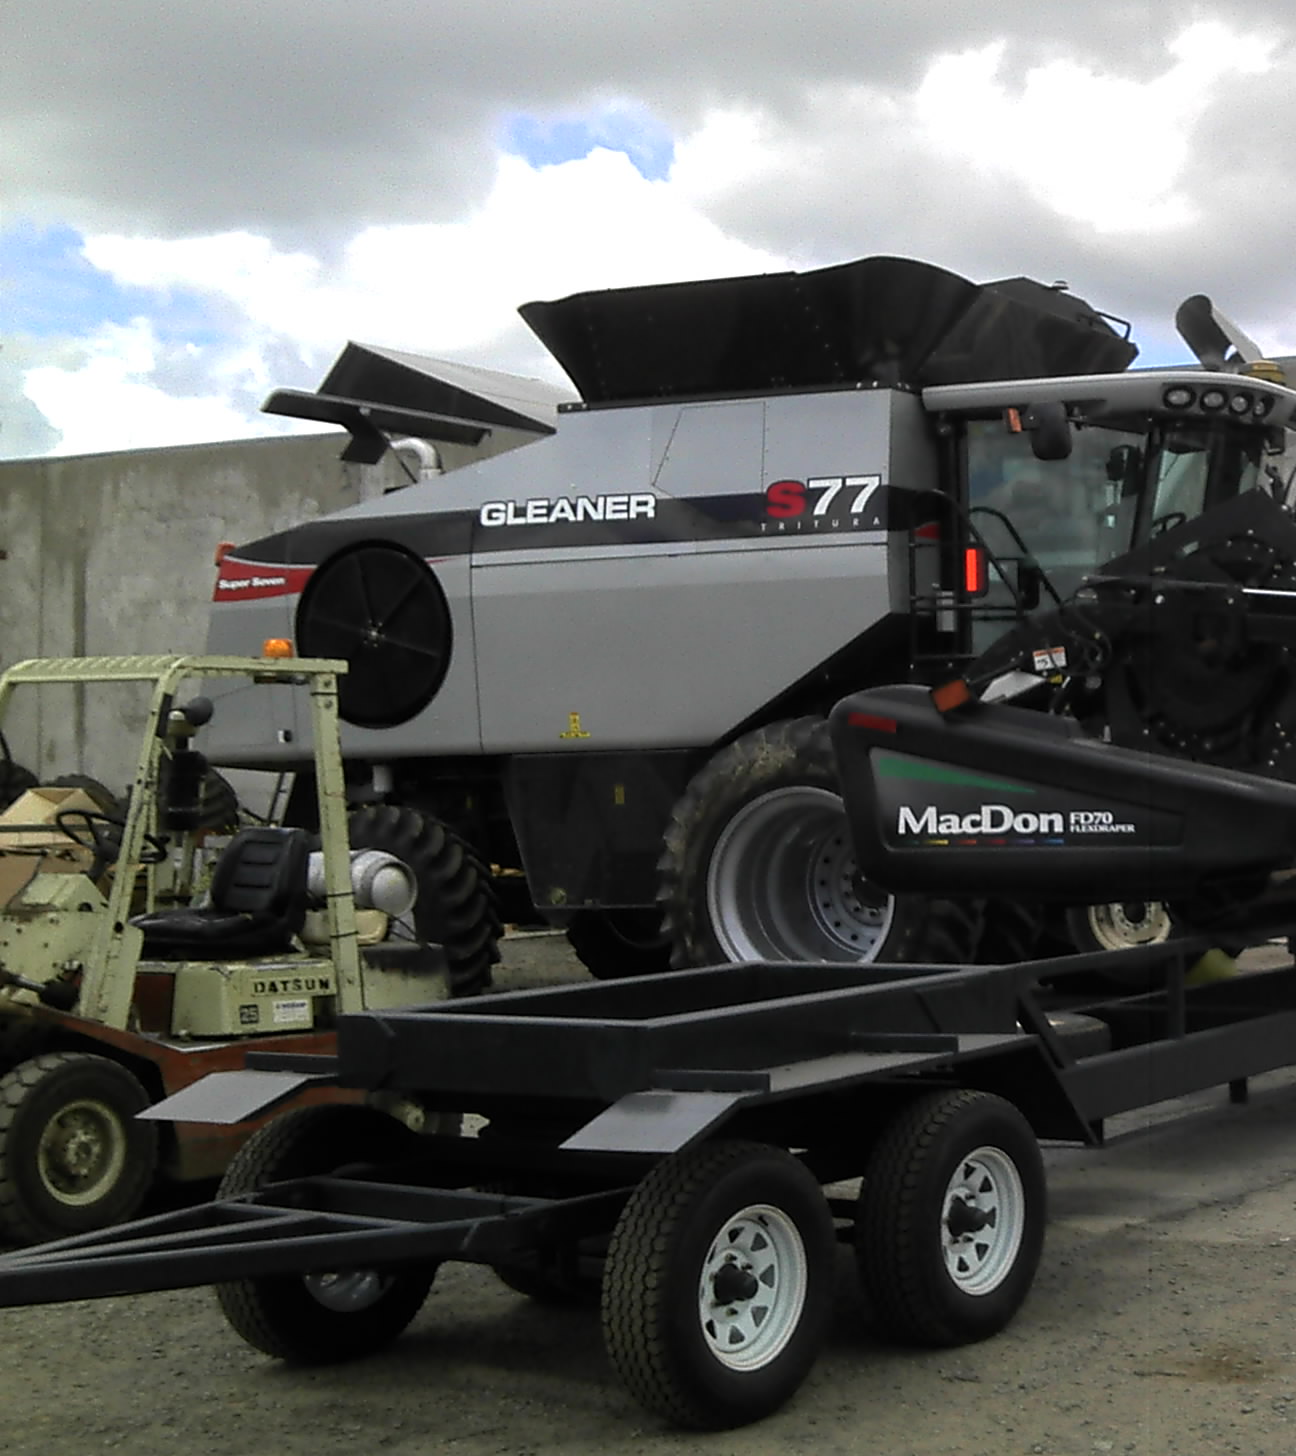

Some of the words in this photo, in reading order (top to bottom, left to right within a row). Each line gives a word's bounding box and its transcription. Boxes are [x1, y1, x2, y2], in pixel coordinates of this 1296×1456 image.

[766, 475, 881, 518] S77
[480, 494, 656, 526] GLEANER
[761, 516, 880, 531] TRITURA
[219, 579, 250, 590] Super
[251, 577, 286, 587] Seven
[898, 804, 1064, 834] MacDon
[1070, 811, 1113, 824] FD70
[1070, 824, 1136, 833] FLEXDRAPER
[254, 979, 330, 993] DATSUN
